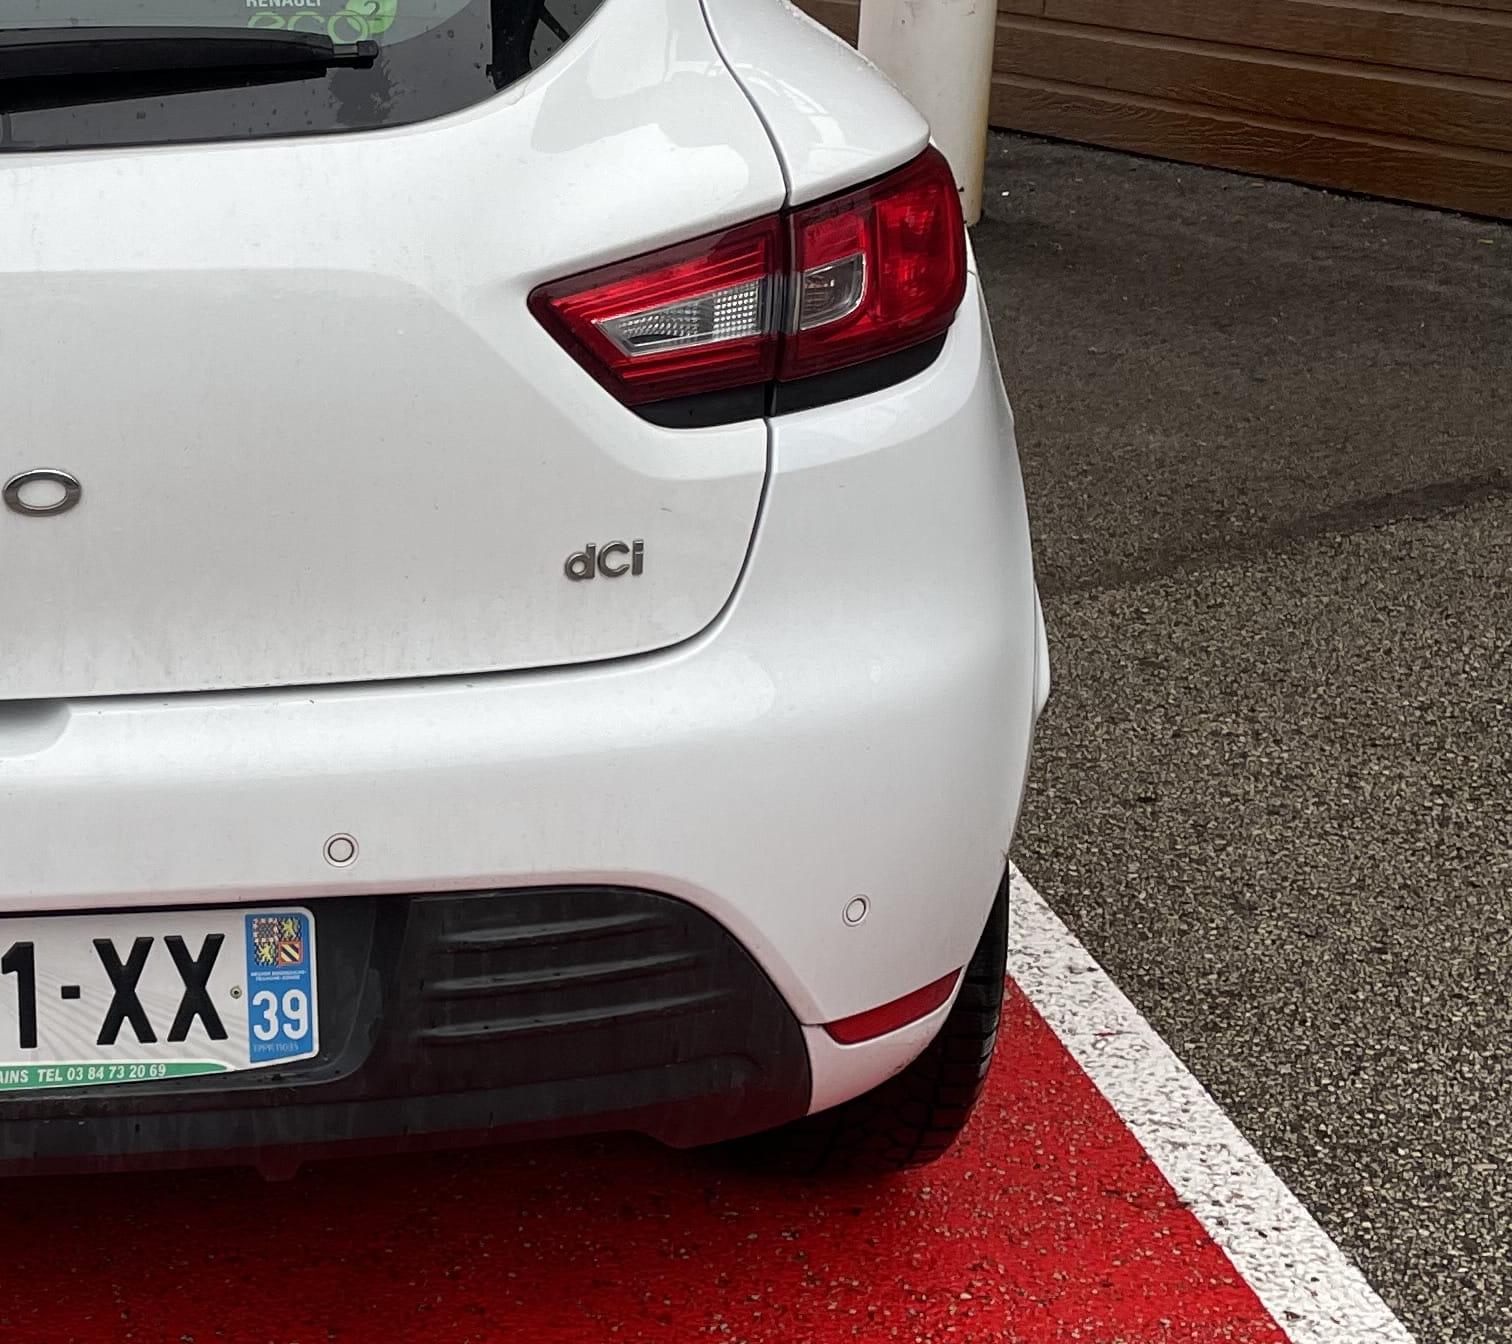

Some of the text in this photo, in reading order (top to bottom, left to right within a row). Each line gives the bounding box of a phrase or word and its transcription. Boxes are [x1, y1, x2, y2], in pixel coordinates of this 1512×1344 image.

[564, 539, 645, 582] dCi
[252, 988, 309, 1041] 39
[37, 1068, 63, 1083] TEL
[67, 1066, 84, 1081] 03
[87, 1065, 105, 1080] 84
[108, 1065, 126, 1080] 73
[128, 1064, 146, 1079] 20
[149, 1063, 167, 1078] 69
